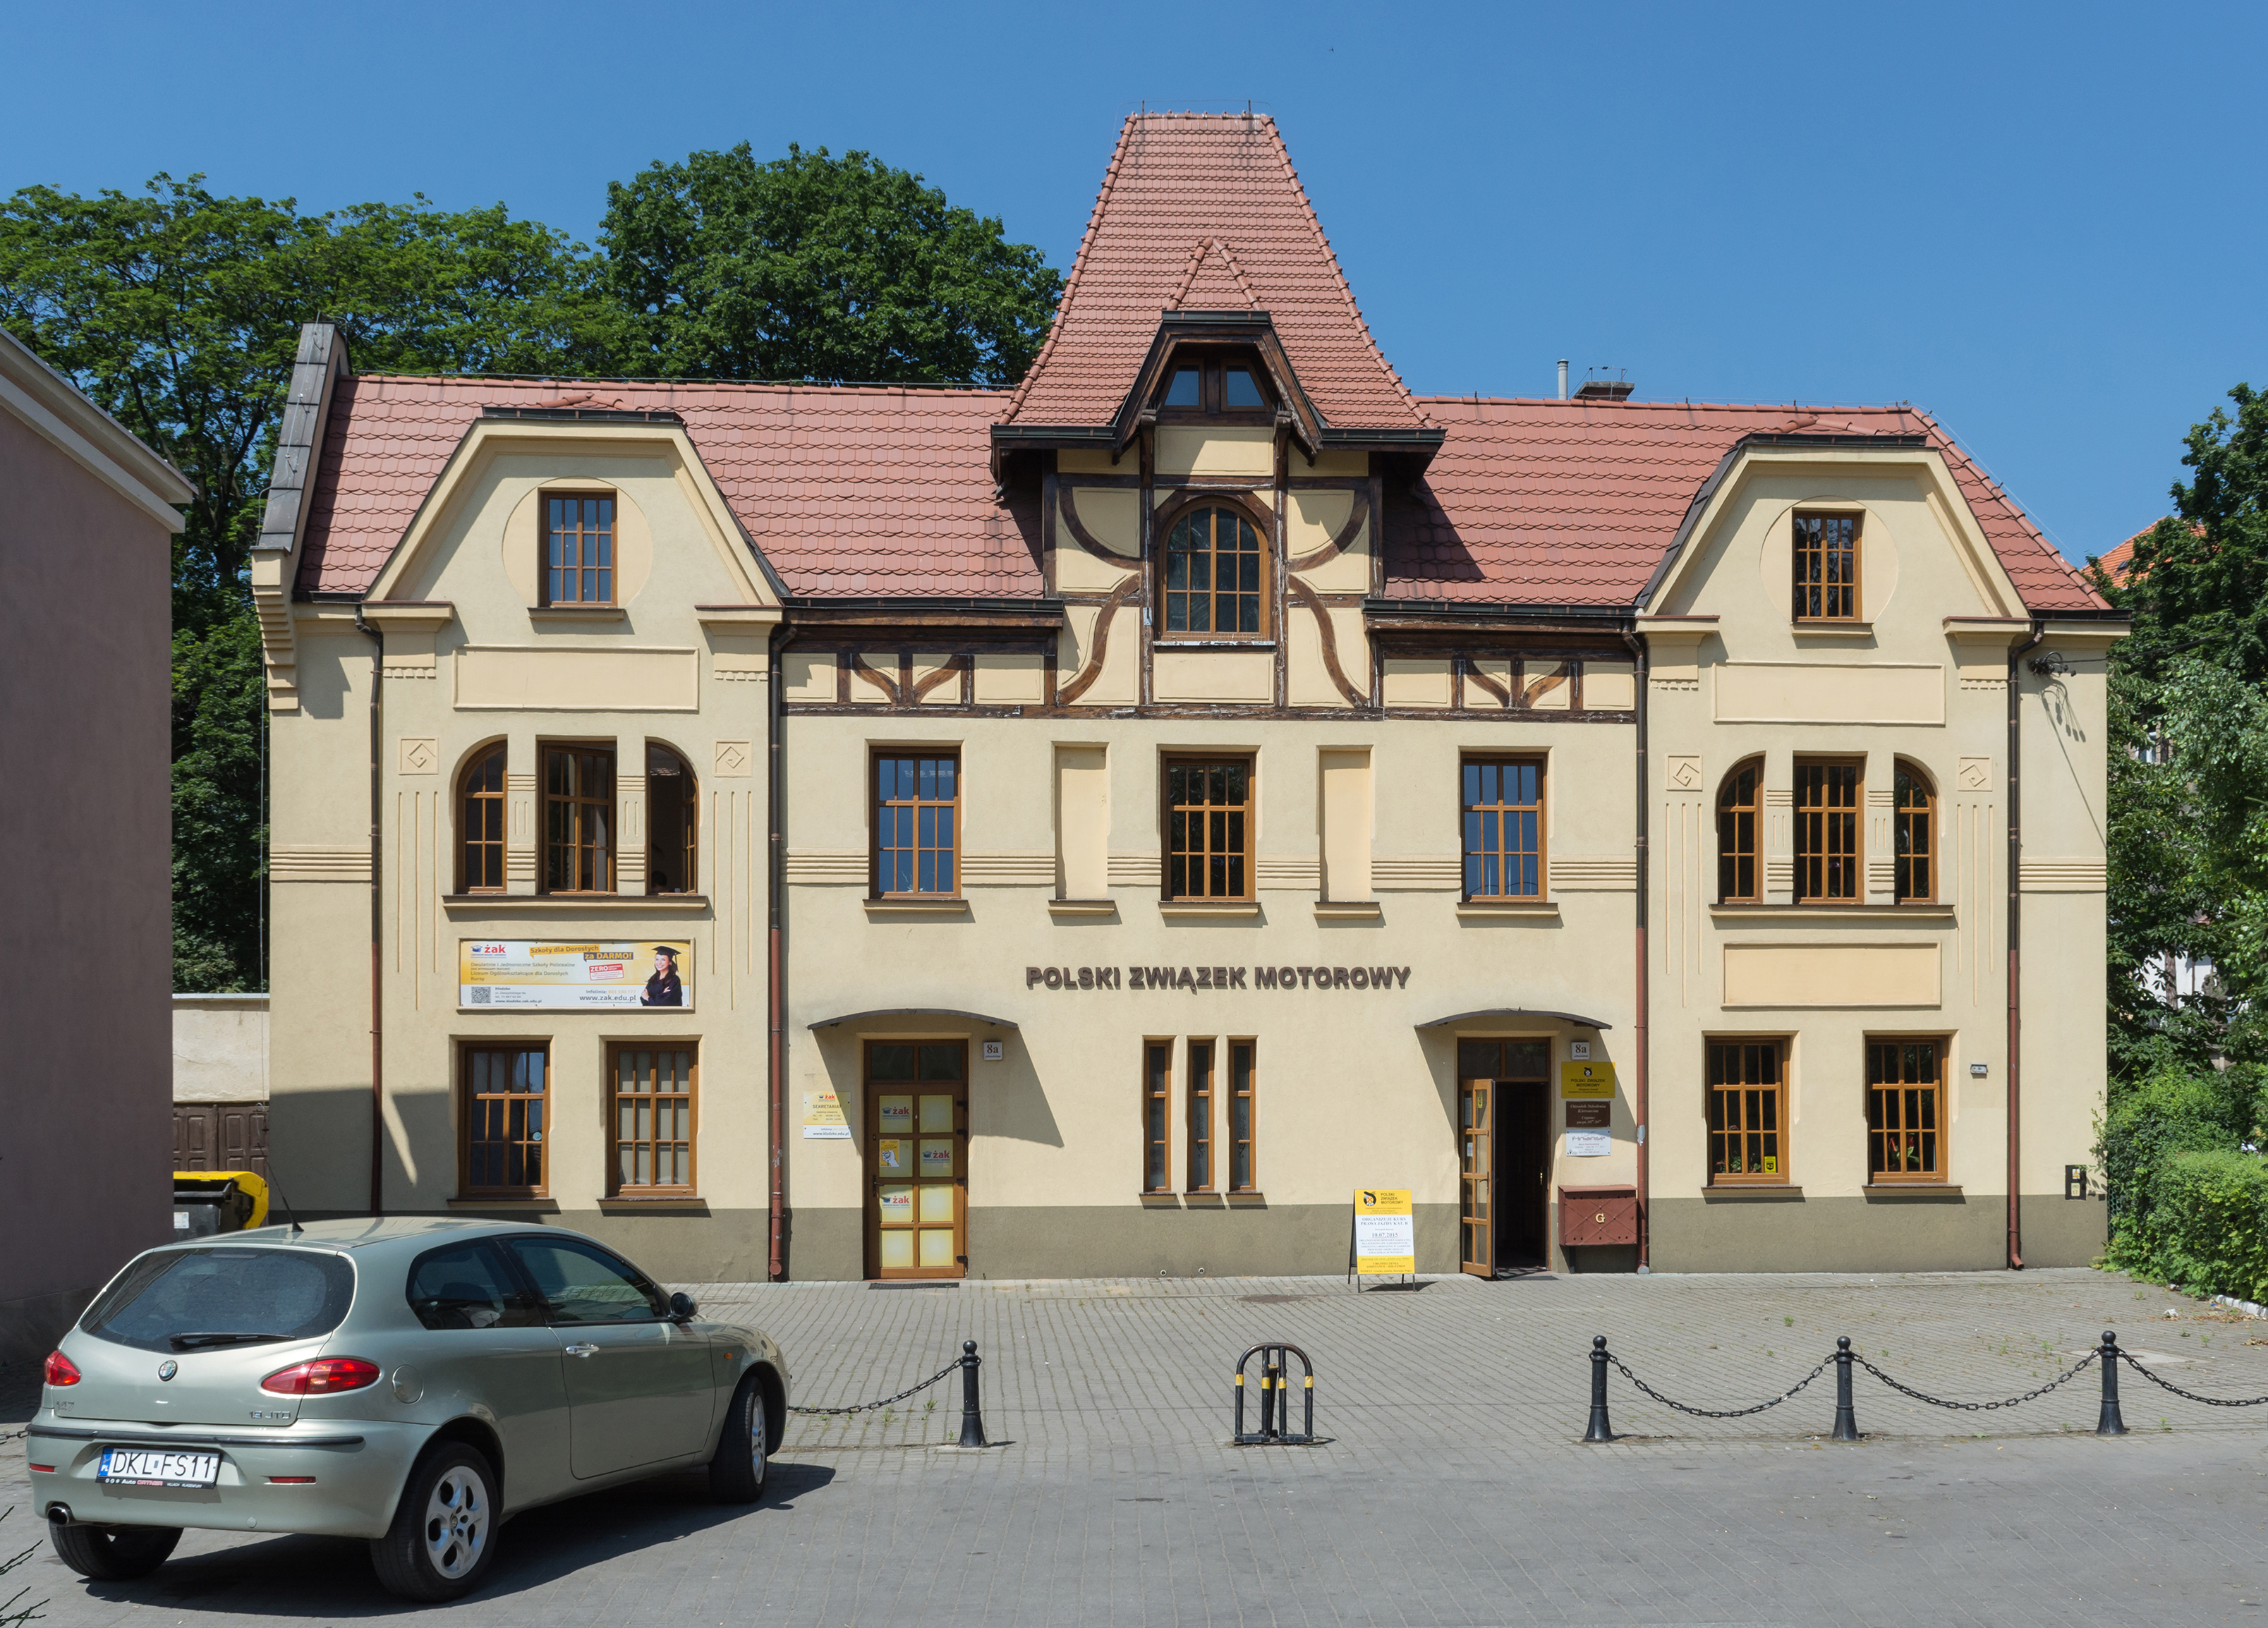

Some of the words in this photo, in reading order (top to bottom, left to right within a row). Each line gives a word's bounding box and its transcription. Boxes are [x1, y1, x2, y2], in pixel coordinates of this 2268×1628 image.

[484, 944, 506, 953] żak
[1026, 966, 1120, 988] POLSKI
[1129, 966, 1247, 995] ZWIĄZEK
[1255, 966, 1412, 989] MOTOROWY
[987, 1044, 999, 1054] 8a
[1575, 1044, 1587, 1053] 8a
[1596, 1213, 1605, 1223] G
[56, 1400, 74, 1411] 147
[265, 1411, 291, 1419] JTD
[113, 1452, 152, 1474] DKL
[161, 1454, 211, 1478] FS11
